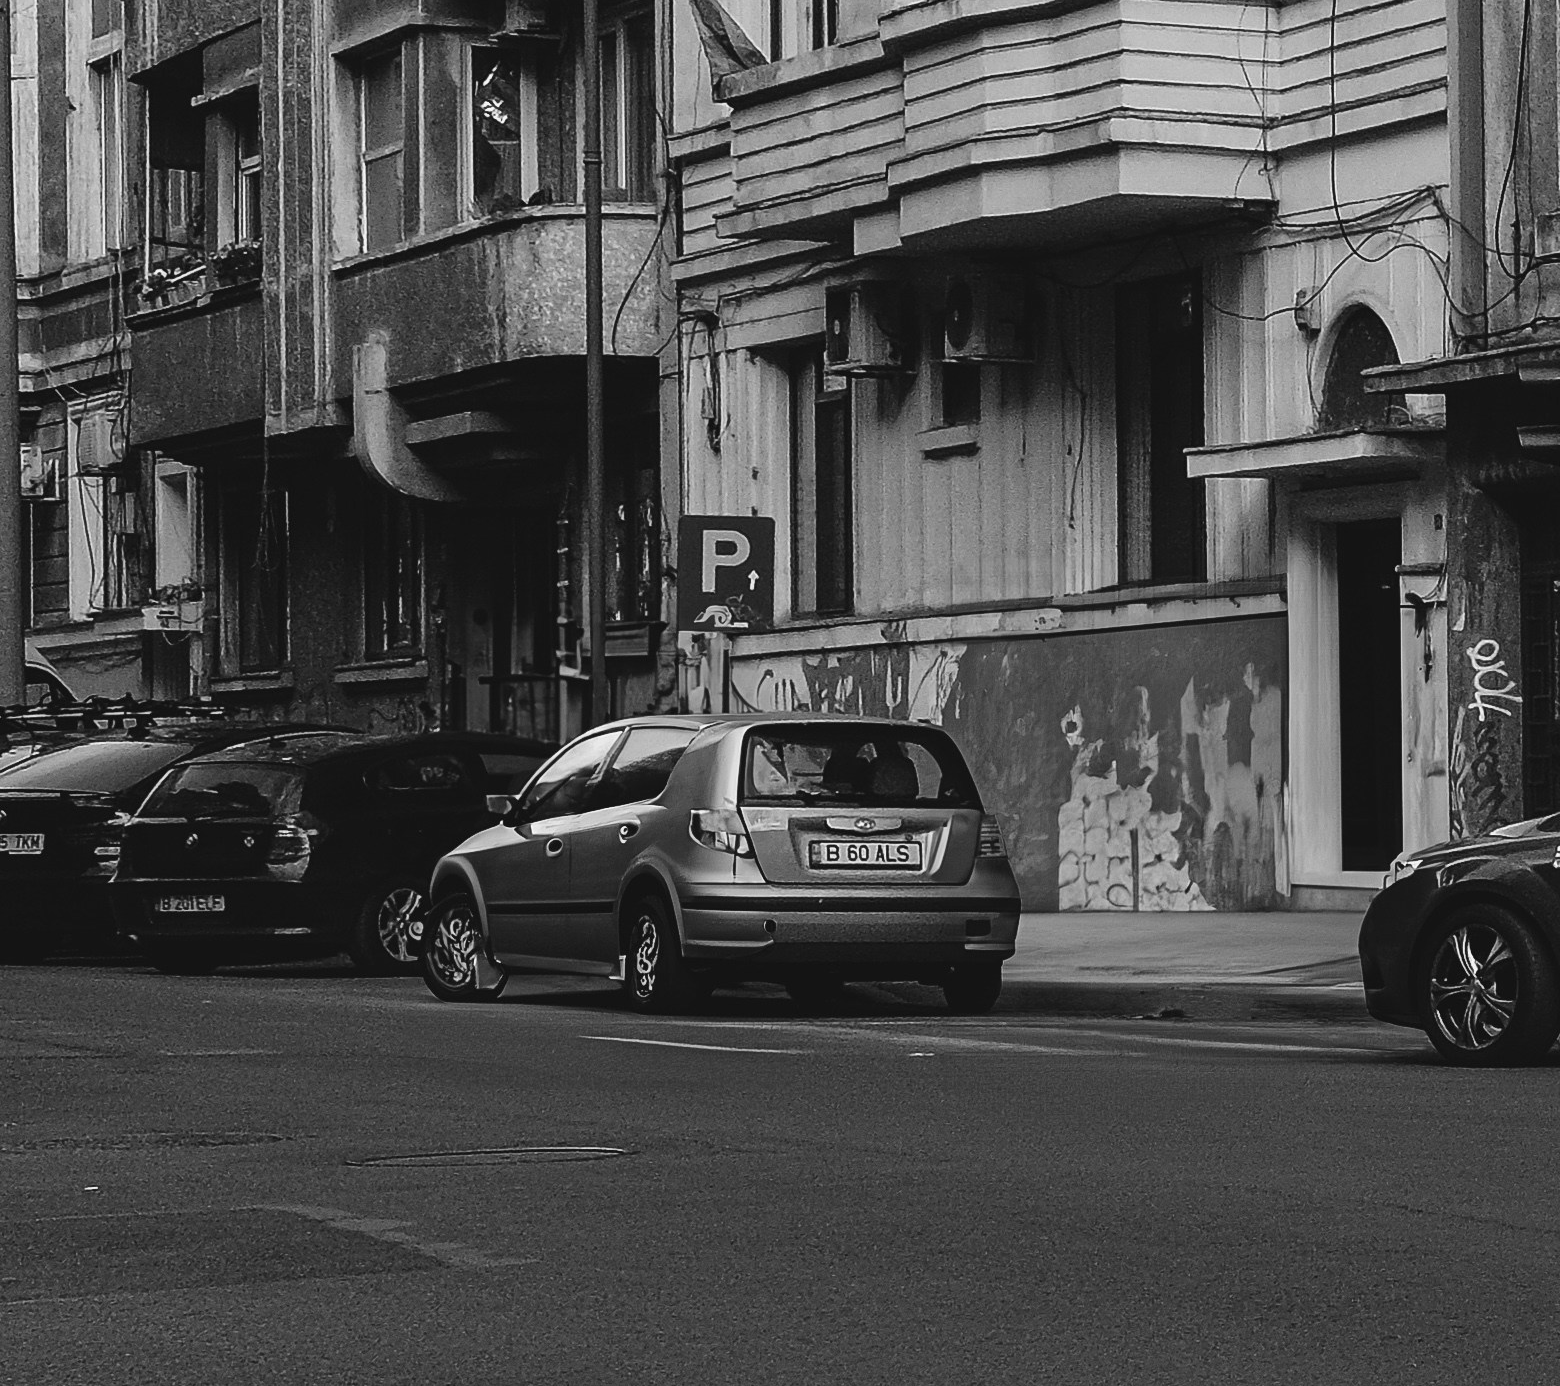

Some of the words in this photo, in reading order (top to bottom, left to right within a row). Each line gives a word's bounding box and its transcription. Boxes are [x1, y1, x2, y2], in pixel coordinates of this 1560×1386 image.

[702, 530, 750, 592] P
[826, 844, 840, 862] B
[847, 844, 870, 862] 60
[875, 844, 909, 863] ALS
